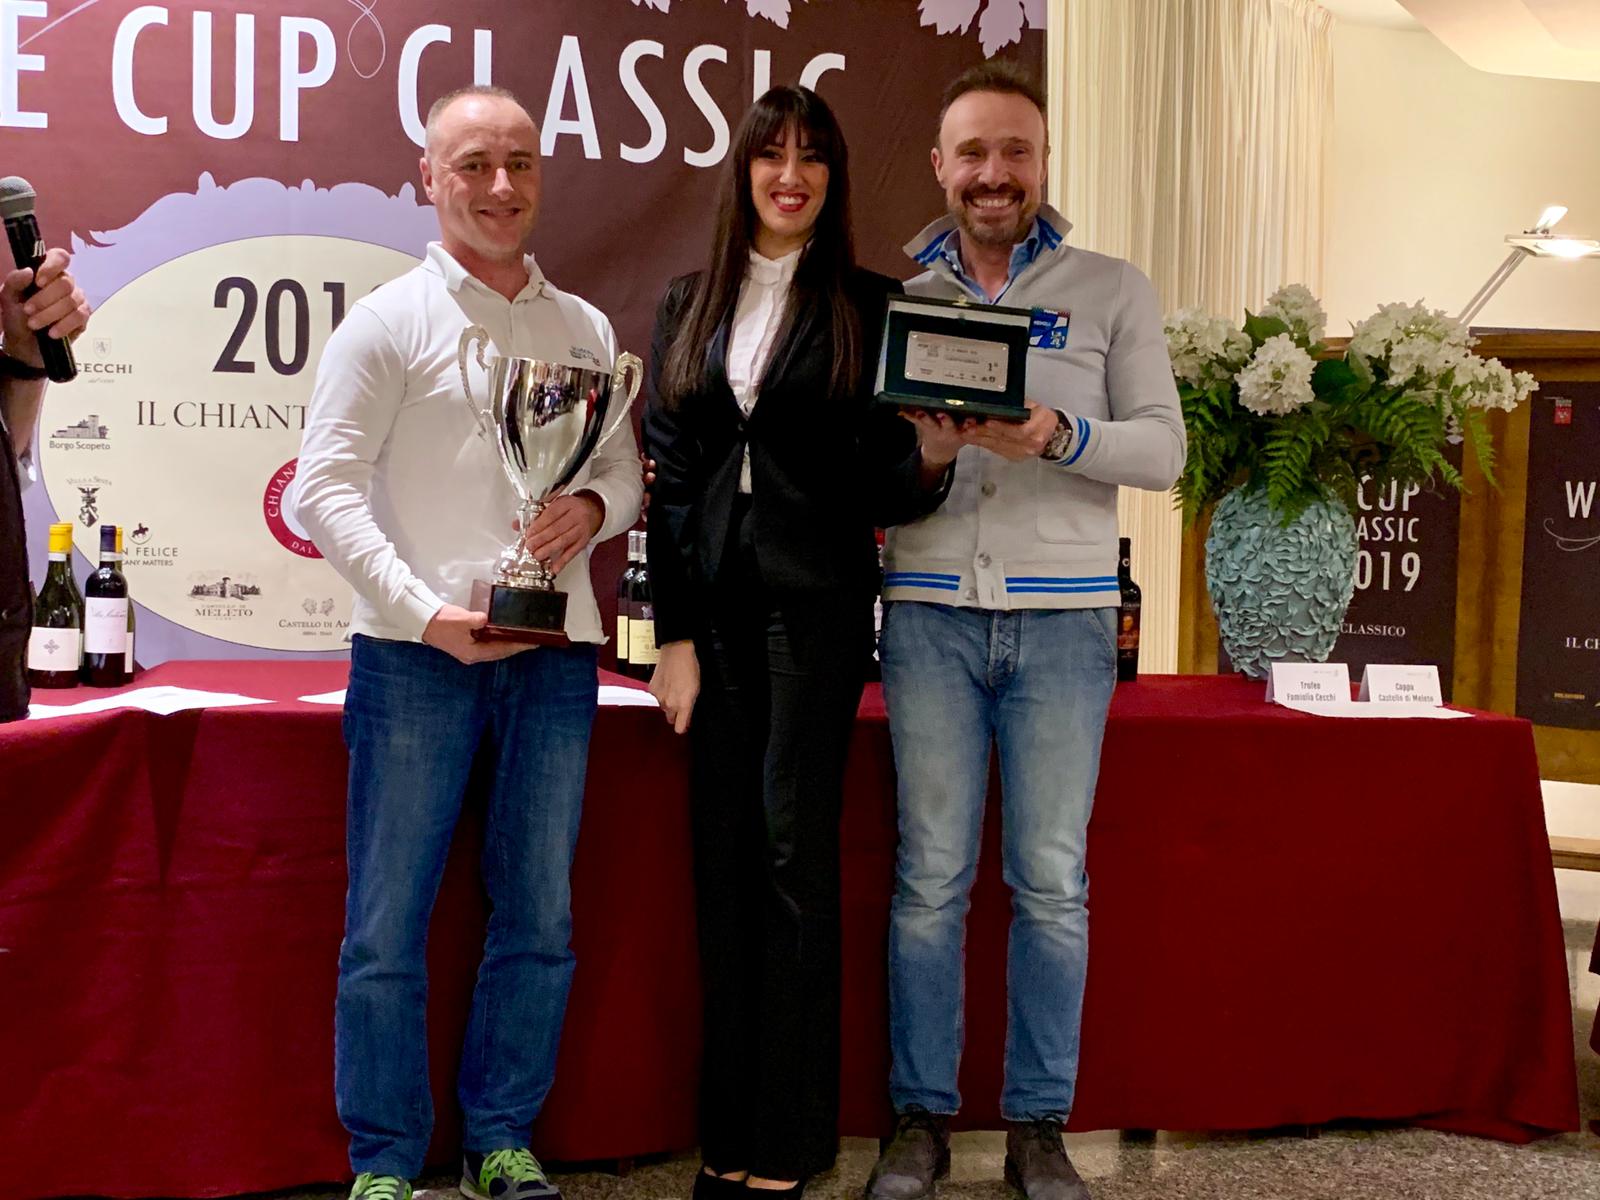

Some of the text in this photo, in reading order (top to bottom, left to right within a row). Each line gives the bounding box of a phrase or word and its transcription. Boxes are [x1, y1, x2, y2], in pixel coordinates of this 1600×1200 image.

[112, 5, 336, 142] CUP
[212, 276, 383, 376] 201
[137, 401, 166, 427] IL
[49, 440, 111, 451] Borgo Scopeto
[267, 463, 298, 518] CHIAN
[136, 547, 179, 558] FELICE
[292, 541, 312, 554] DAL
[142, 559, 174, 567] MATTERS
[195, 608, 253, 617] MELETO
[1340, 622, 1406, 637] CLASSICO
[1565, 636, 1581, 649] IL
[1300, 681, 1321, 690] Trofeo
[1395, 683, 1415, 692] Coppa
[1315, 693, 1336, 702] Cecchi
